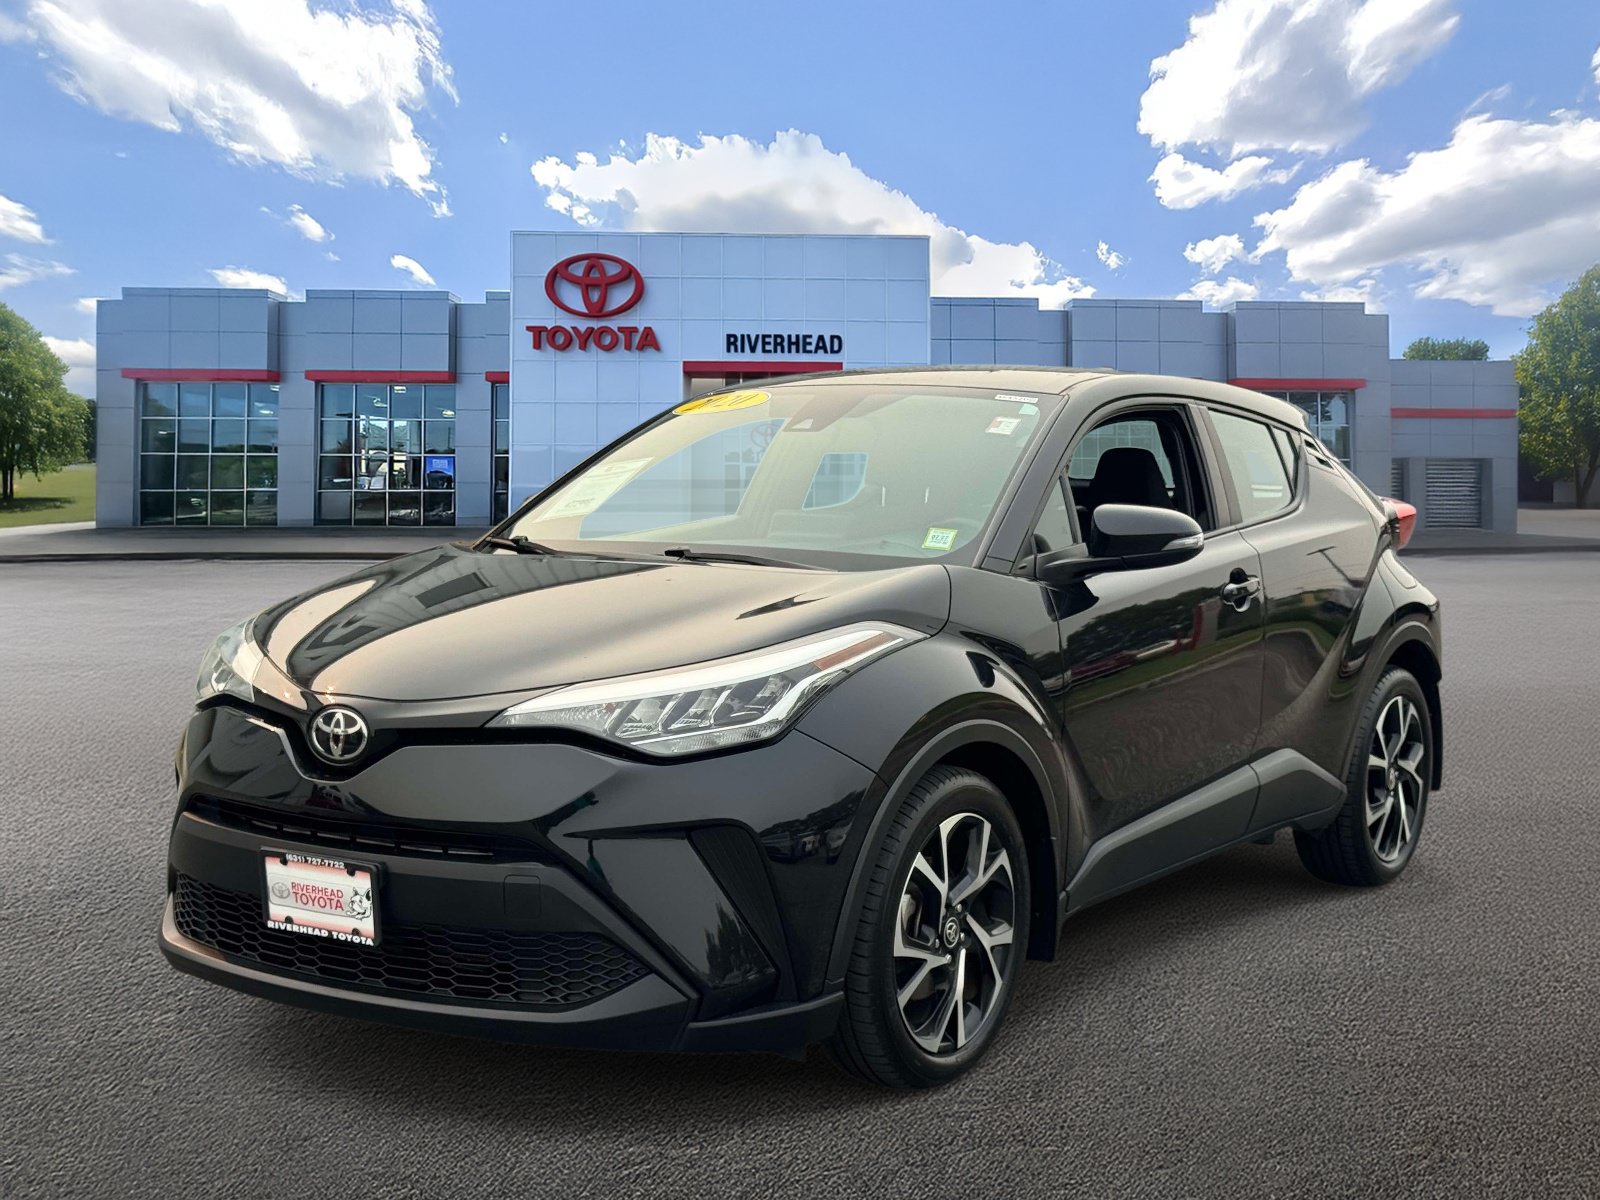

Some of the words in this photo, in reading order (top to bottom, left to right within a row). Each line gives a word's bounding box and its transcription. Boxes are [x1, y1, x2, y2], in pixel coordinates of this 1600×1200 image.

[526, 325, 661, 352] TOYOTA
[726, 333, 843, 354] RIVERHEAD
[291, 881, 344, 899] RIVERHEAD
[292, 891, 345, 912] TOYOTA
[267, 920, 329, 937] RIVERHEAD
[331, 931, 374, 946] TOYOTA
